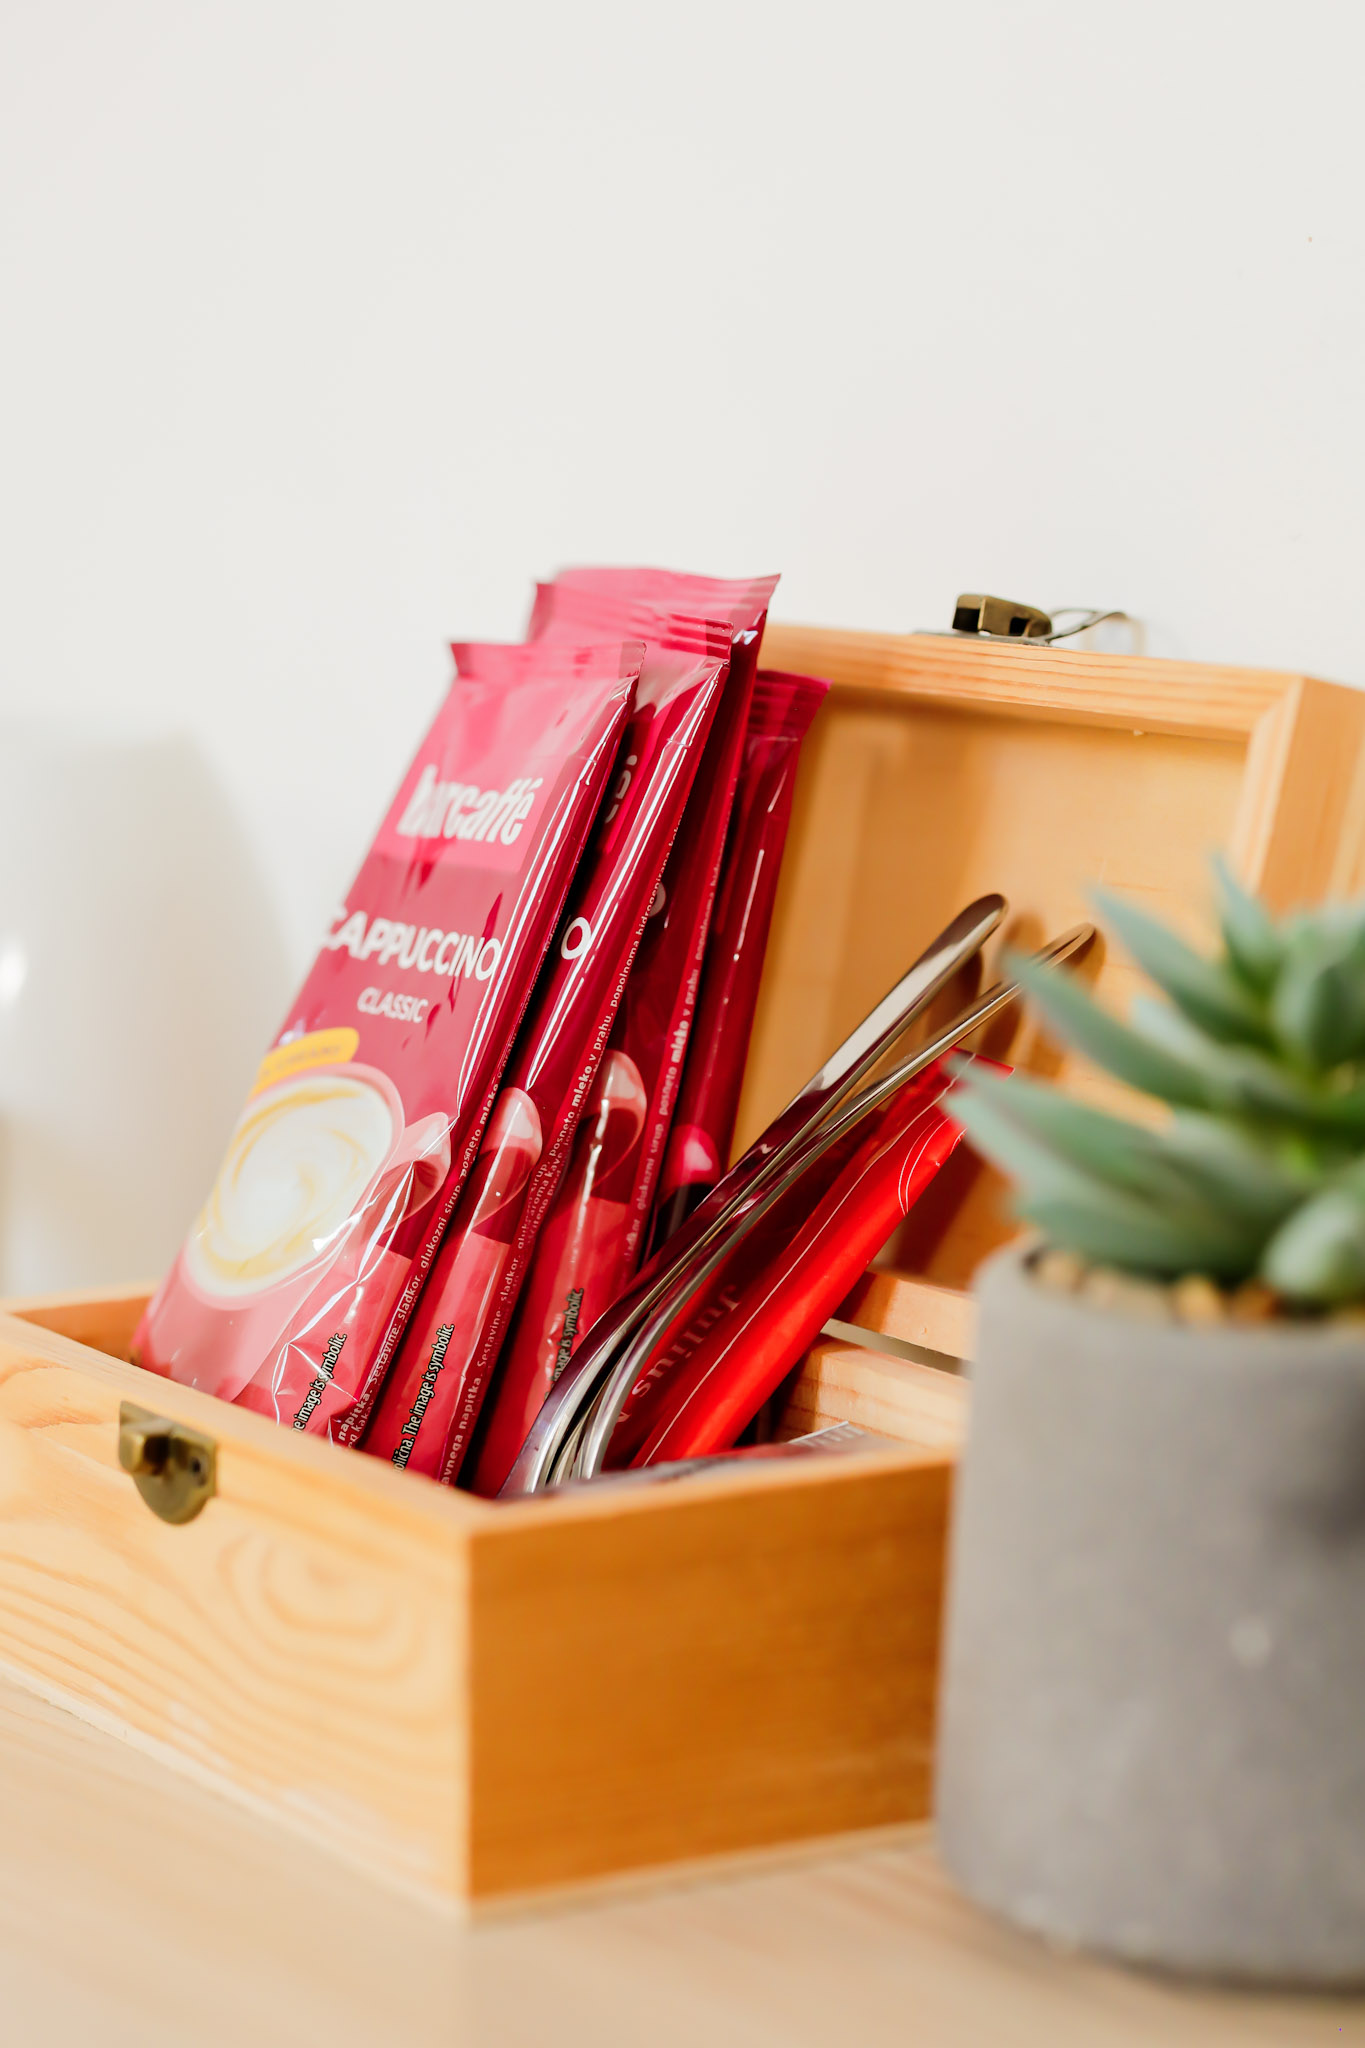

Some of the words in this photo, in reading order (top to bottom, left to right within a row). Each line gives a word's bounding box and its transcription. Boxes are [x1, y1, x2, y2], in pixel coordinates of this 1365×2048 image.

[396, 763, 543, 846] brcaffé
[357, 986, 429, 1023] CLASSIC
[549, 1111, 575, 1156] posneto
[572, 1064, 592, 1107] mleko
[588, 1053, 597, 1062] v
[593, 1012, 614, 1050] prahu,
[610, 940, 640, 1007] popolnoma
[670, 1020, 689, 1064] mleko
[420, 1217, 447, 1269] glukozni
[459, 1128, 481, 1180] posneto
[479, 1083, 499, 1125] mleko
[562, 1287, 584, 1338] symbolic.
[317, 1332, 347, 1384] symbolic.
[428, 1323, 455, 1373] symbolic.
[562, 1332, 573, 1348] is
[631, 1284, 742, 1398] Julius
[309, 1378, 326, 1393] is
[421, 1371, 437, 1383] is
[294, 1388, 322, 1425] image
[409, 1381, 436, 1417] image
[402, 1415, 422, 1436] The
[392, 1438, 415, 1472] olična.
